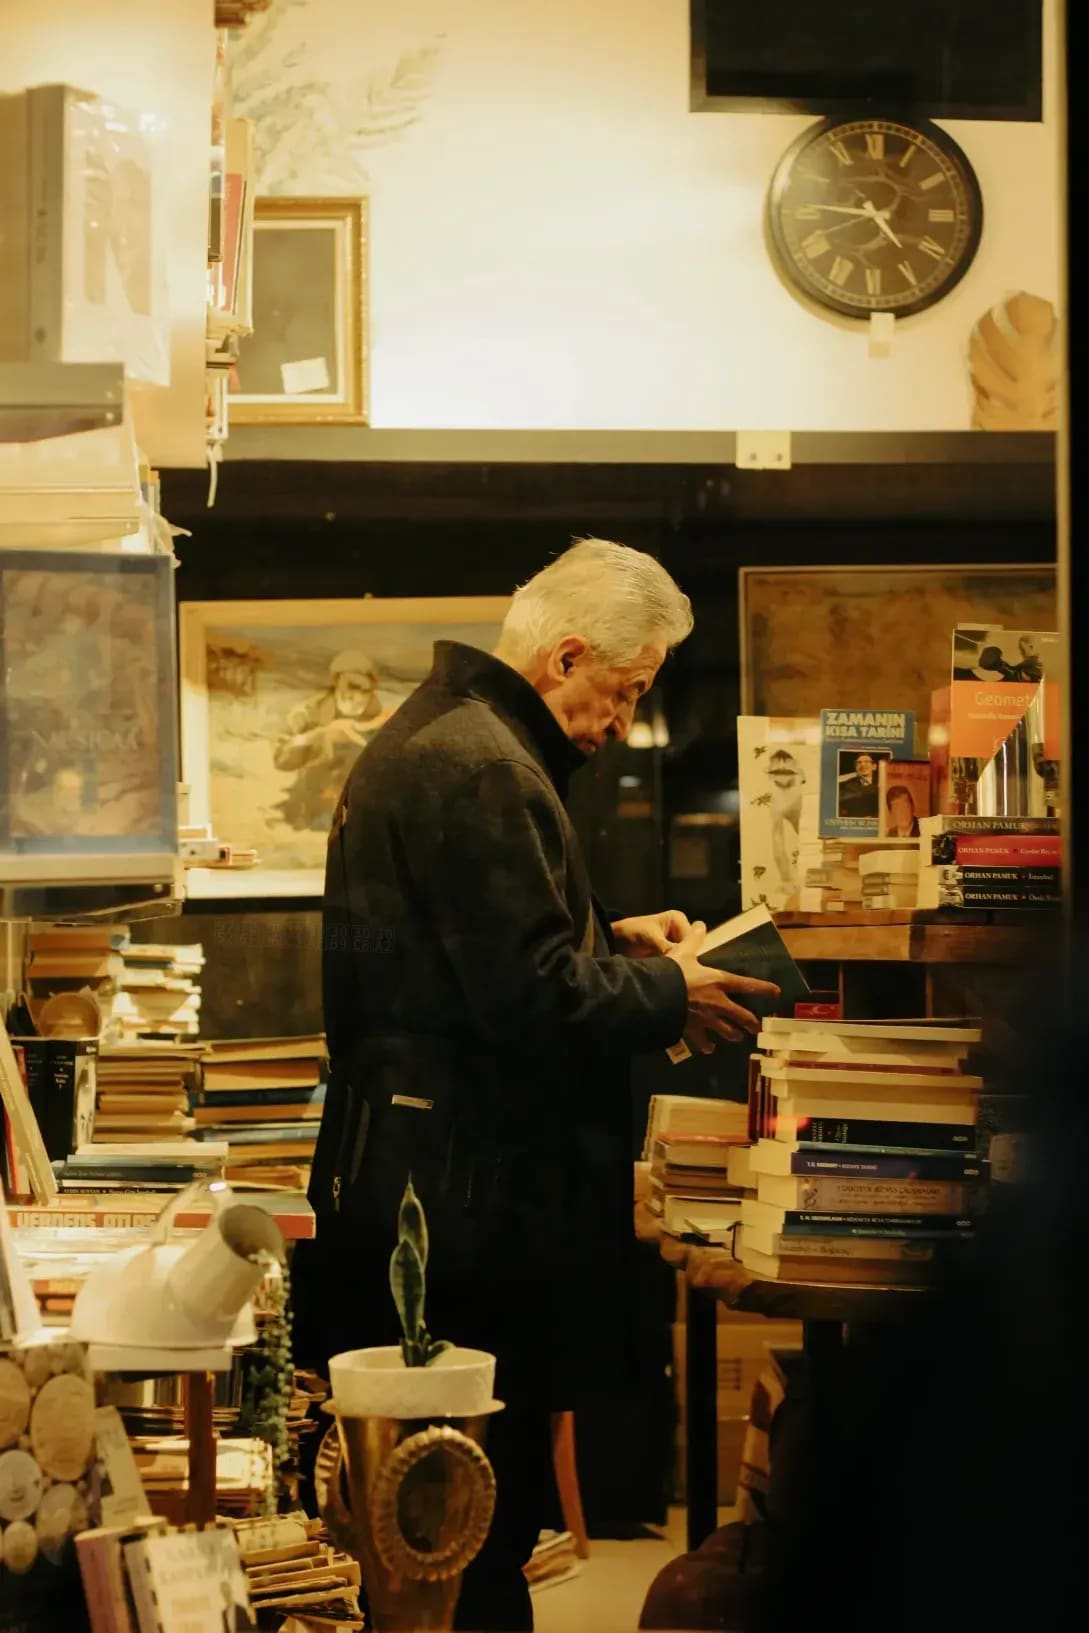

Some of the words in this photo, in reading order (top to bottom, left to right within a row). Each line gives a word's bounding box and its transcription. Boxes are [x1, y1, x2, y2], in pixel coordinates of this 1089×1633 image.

[826, 712, 906, 726] ZAMANIN
[825, 726, 858, 737] KISA
[952, 820, 990, 830] ORHAN
[992, 821, 1028, 830] PAMUK
[964, 872, 992, 880] ORHAN
[965, 892, 992, 900] ORHAN
